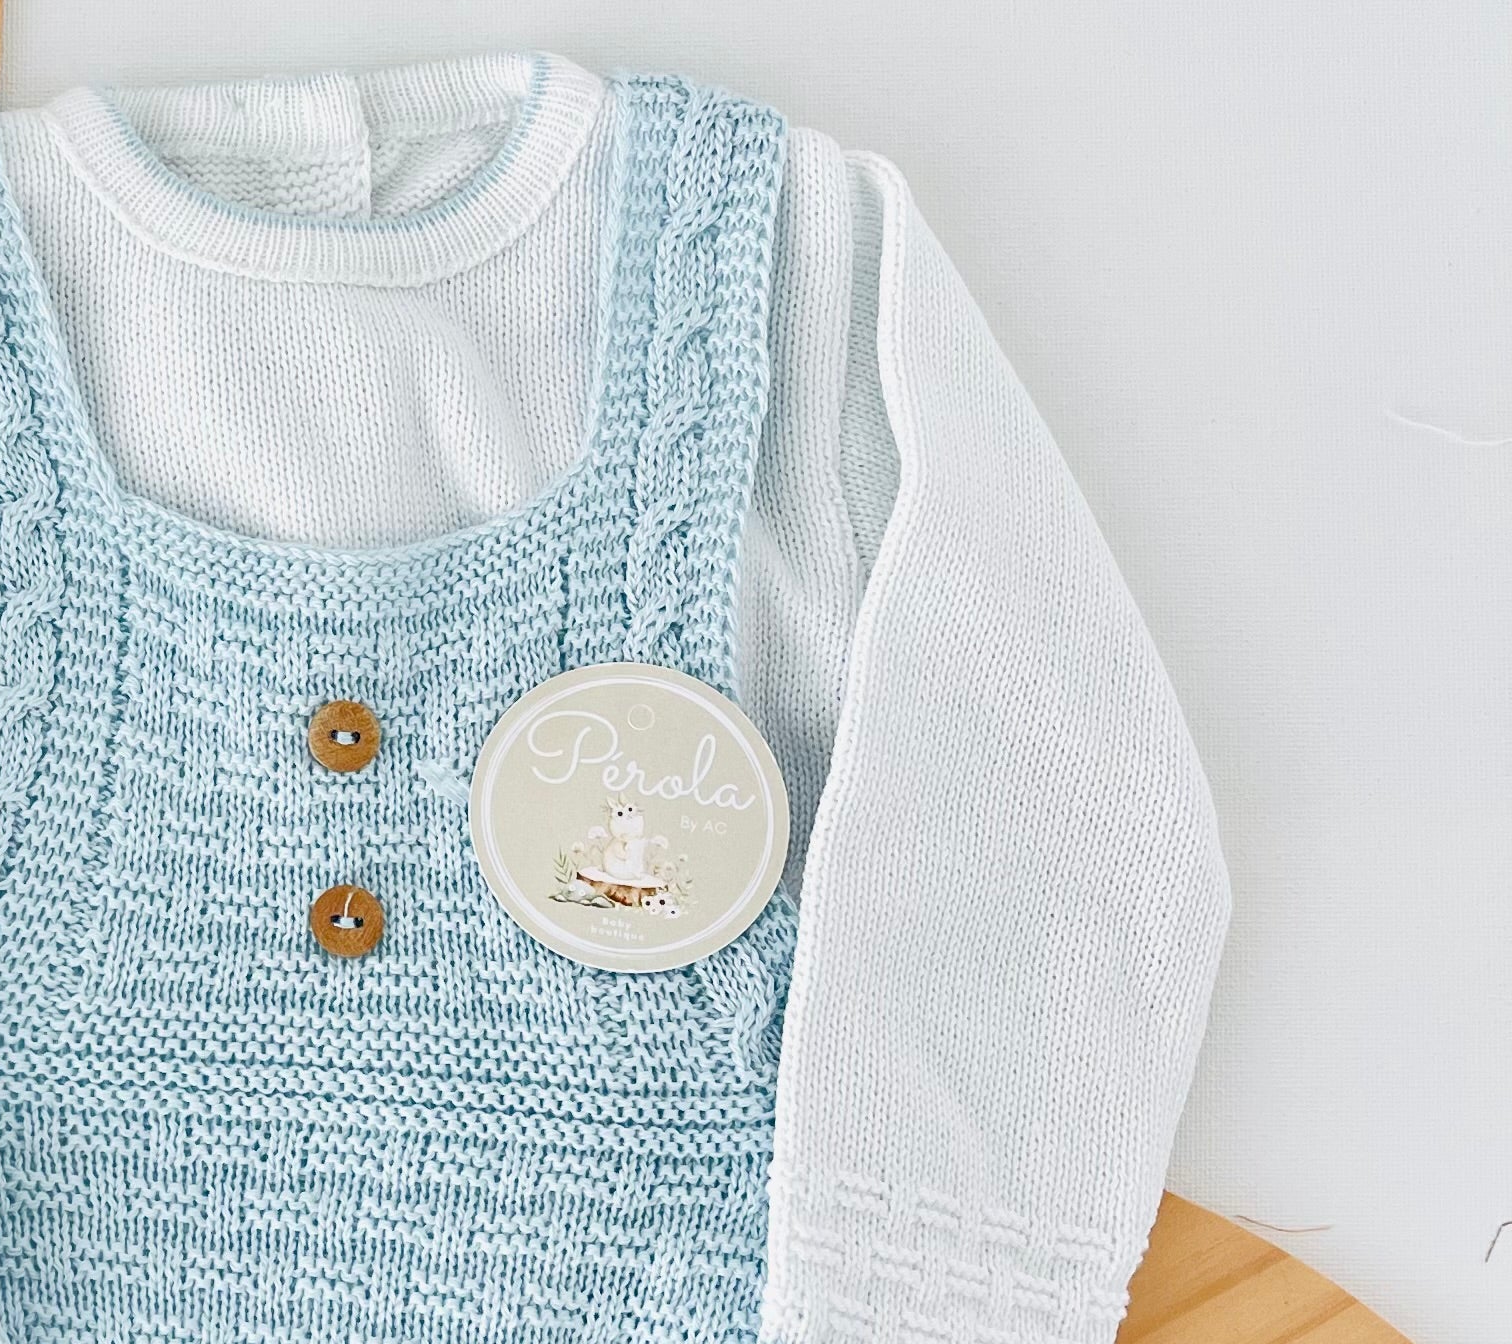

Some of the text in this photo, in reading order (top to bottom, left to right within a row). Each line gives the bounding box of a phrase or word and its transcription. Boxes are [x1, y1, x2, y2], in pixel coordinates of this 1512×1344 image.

[527, 710, 756, 810] Pérola
[680, 816, 727, 834] By AC
